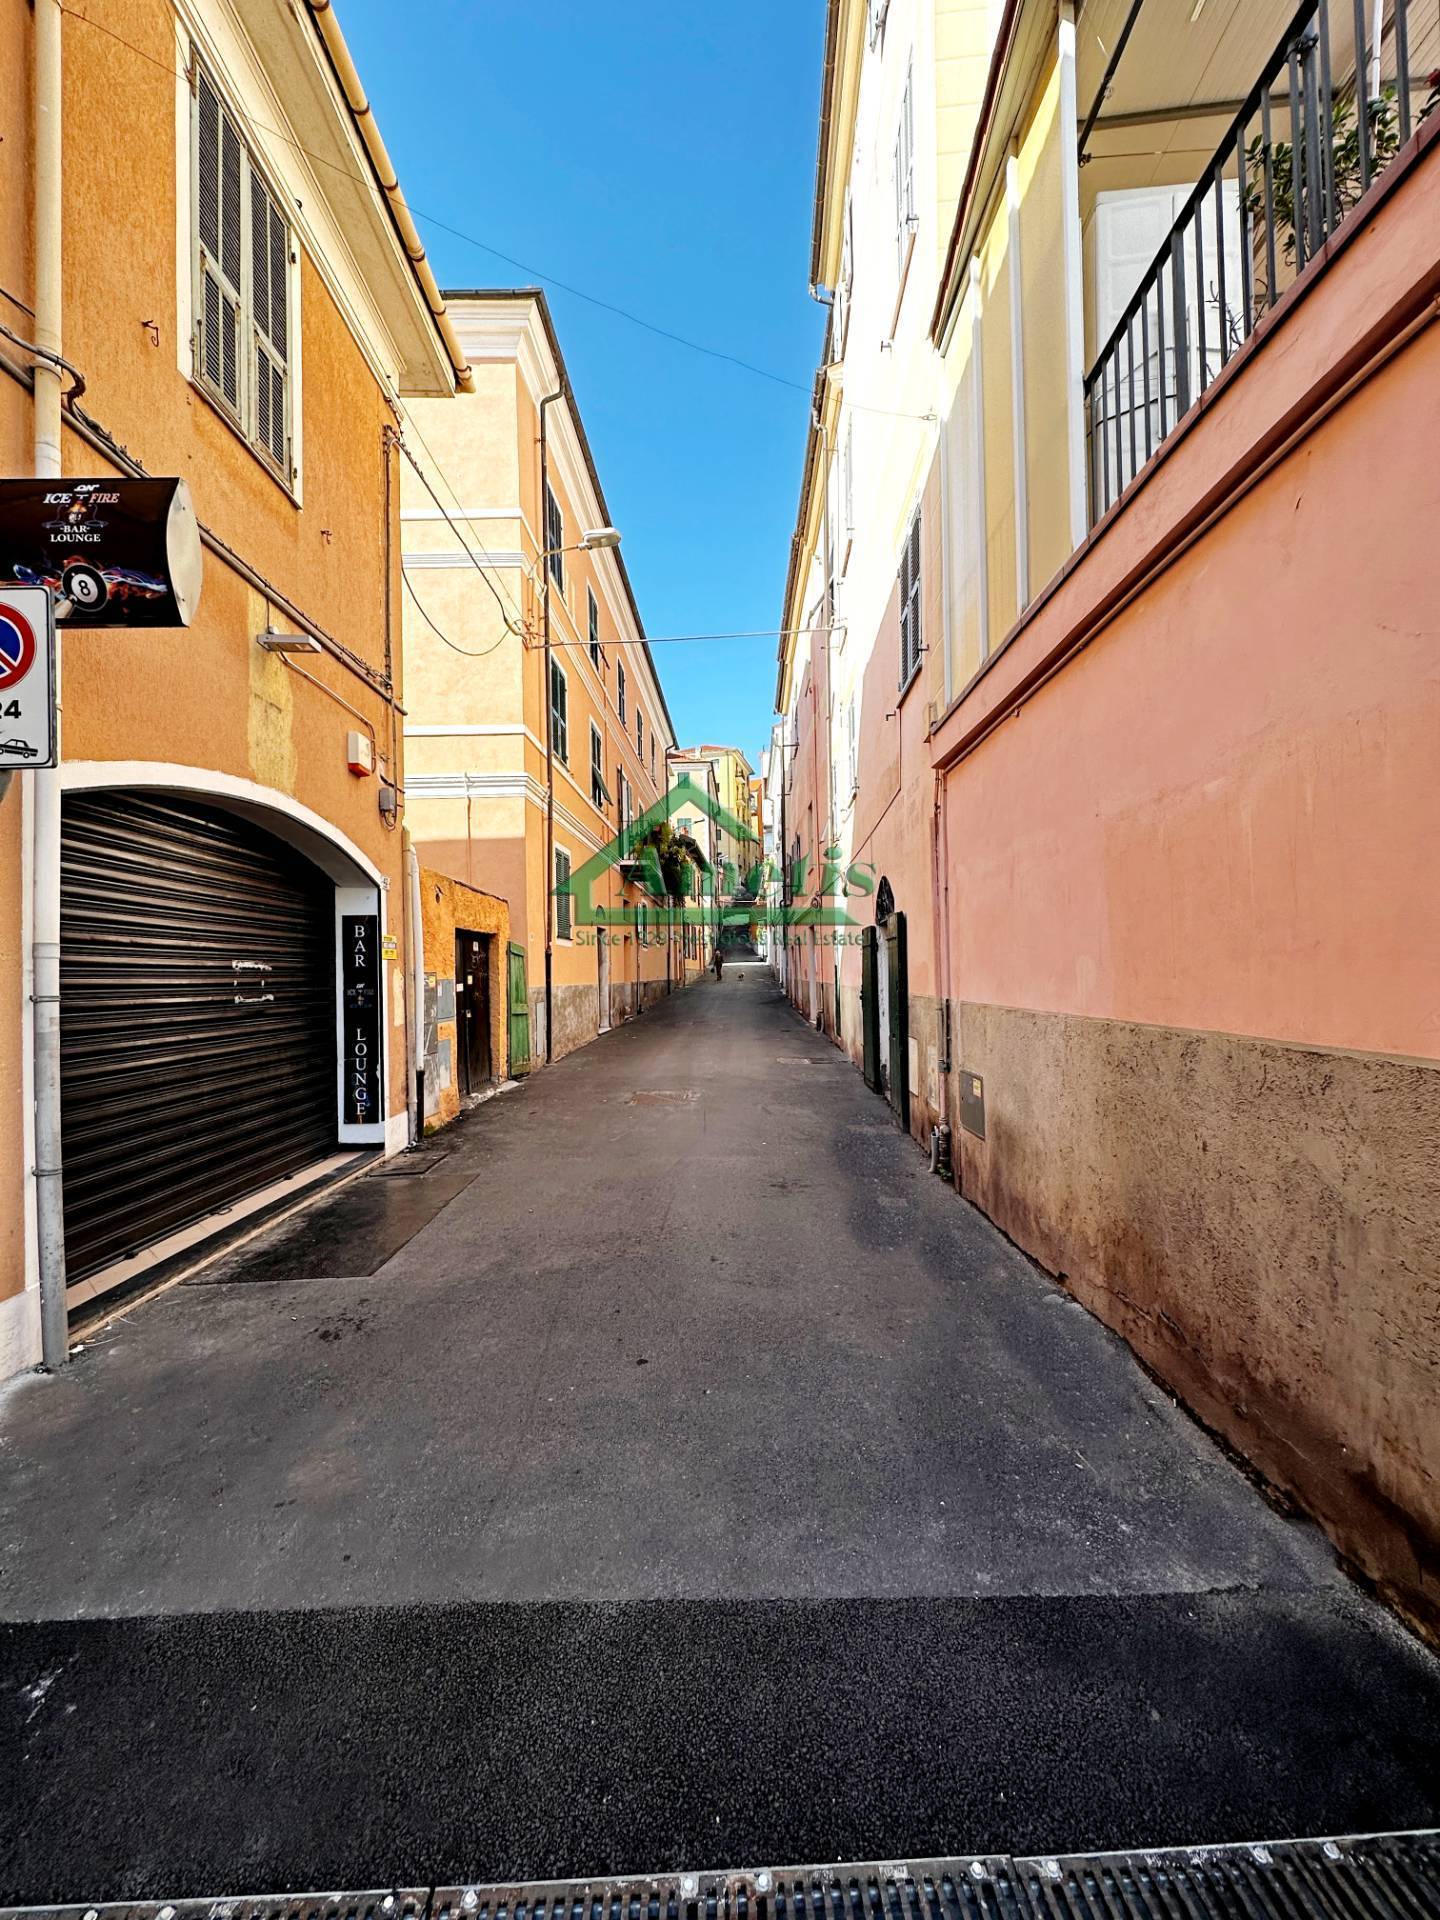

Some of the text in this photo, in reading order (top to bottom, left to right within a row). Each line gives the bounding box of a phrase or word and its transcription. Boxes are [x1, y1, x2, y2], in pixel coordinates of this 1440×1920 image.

[43, 493, 120, 504] ICE FIRE
[50, 534, 101, 543] LOUNGE
[78, 579, 91, 596] 8
[0, 699, 21, 719] 4
[354, 925, 366, 967] BAR
[354, 1028, 368, 1115] LOUNGE
